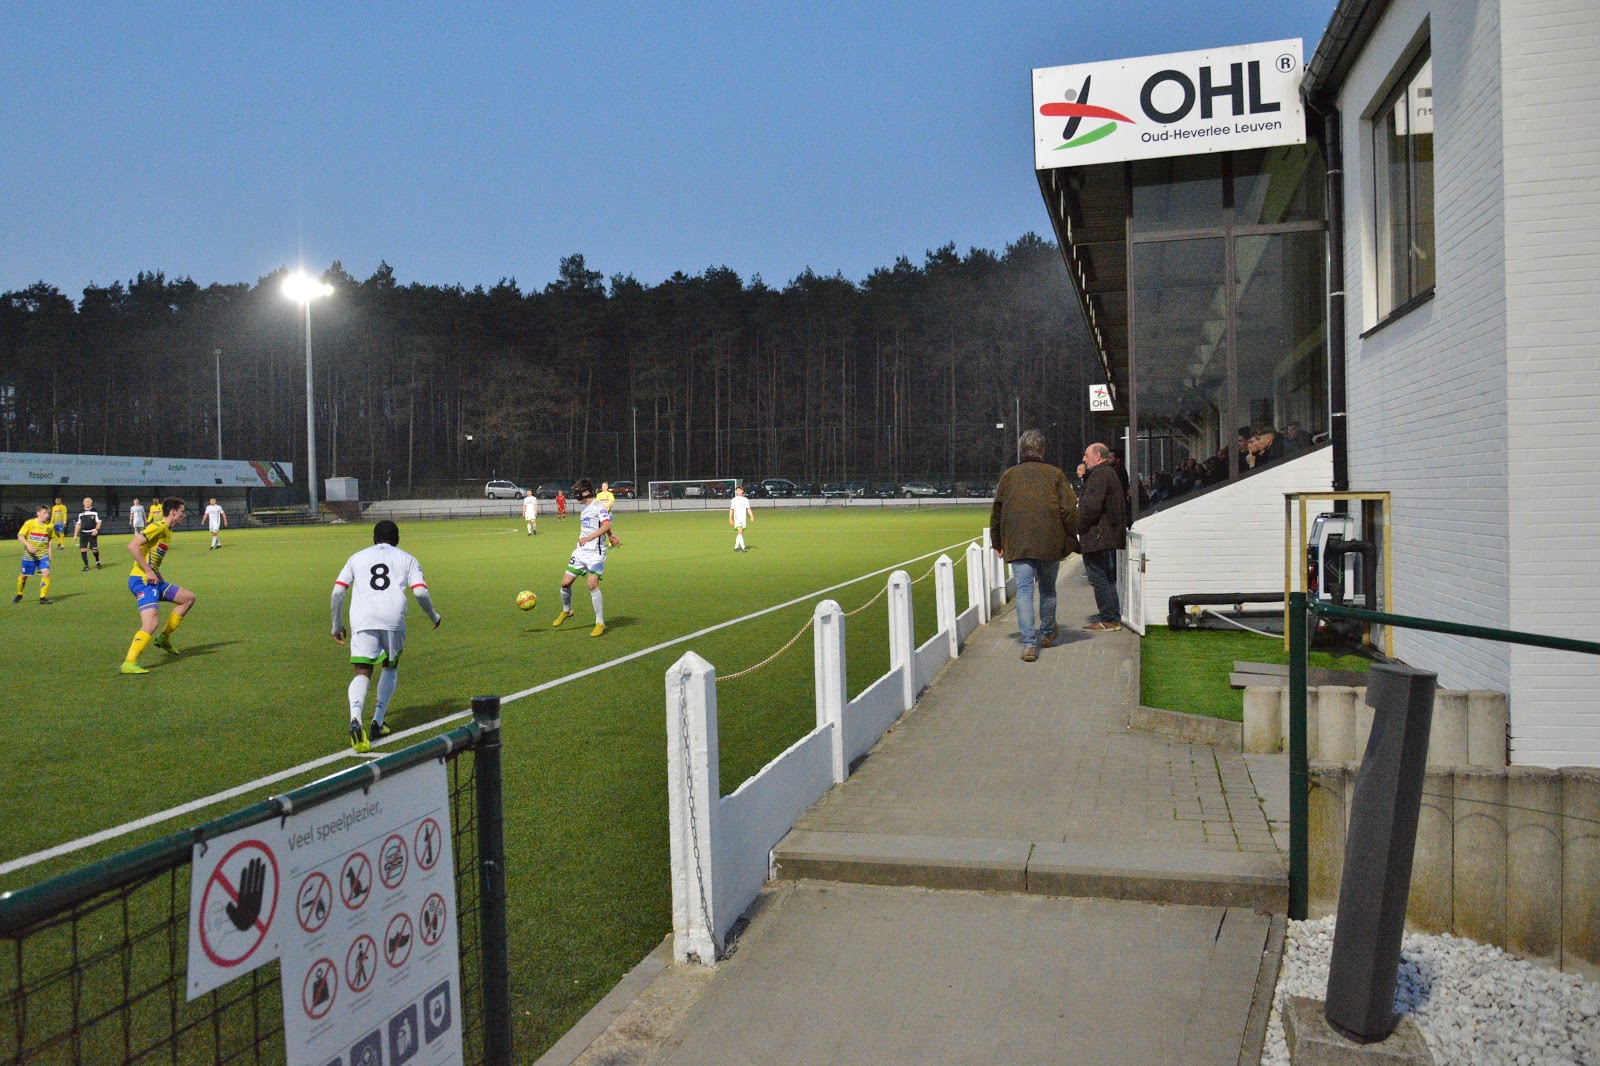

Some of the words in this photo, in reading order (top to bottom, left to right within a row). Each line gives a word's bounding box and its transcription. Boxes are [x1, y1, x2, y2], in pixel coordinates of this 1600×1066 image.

[1140, 60, 1281, 124] OHL
[1141, 126, 1231, 143] Oud-Heverlee
[1234, 121, 1282, 134] Leuven
[1092, 399, 1110, 407] OHL
[28, 471, 53, 480] Respect
[369, 563, 391, 591] 8
[288, 825, 314, 851] Veel
